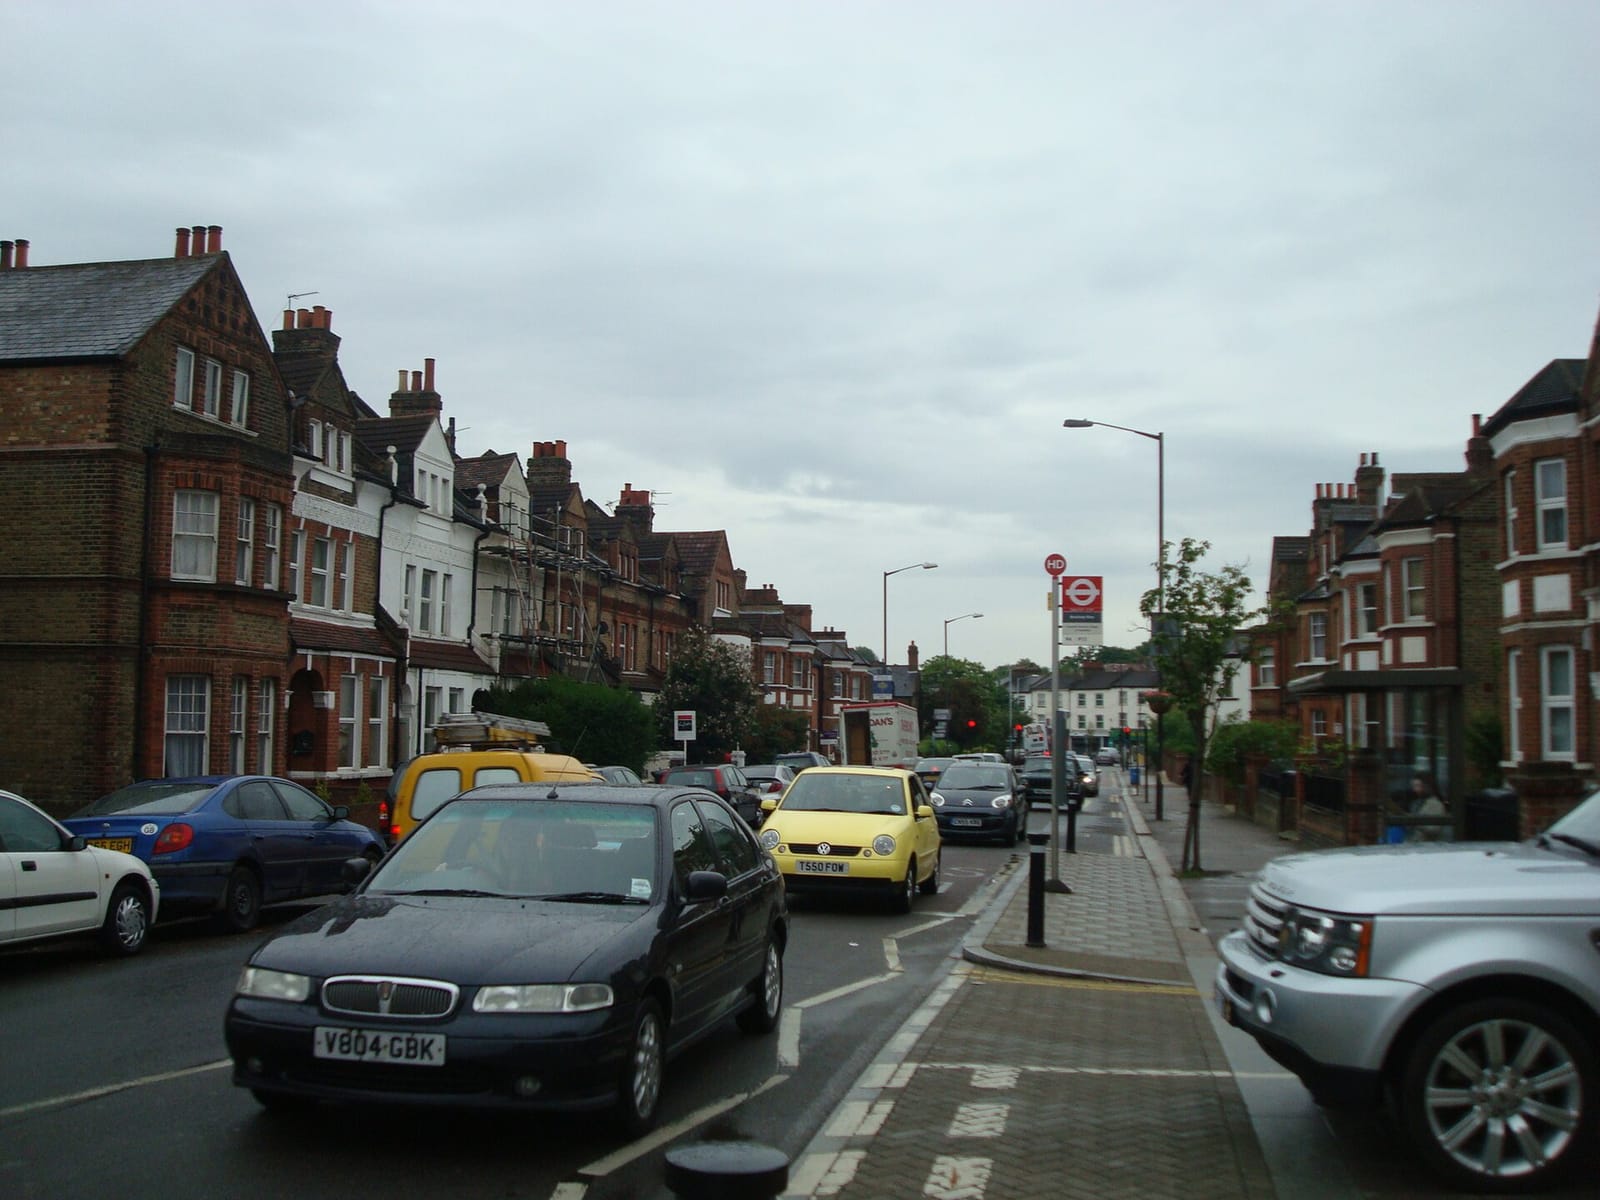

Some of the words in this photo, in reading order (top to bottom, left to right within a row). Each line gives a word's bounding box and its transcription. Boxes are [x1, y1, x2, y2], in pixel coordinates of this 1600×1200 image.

[1047, 559, 1064, 569] HD
[325, 1031, 382, 1057] V804
[389, 1036, 435, 1061] GBK
